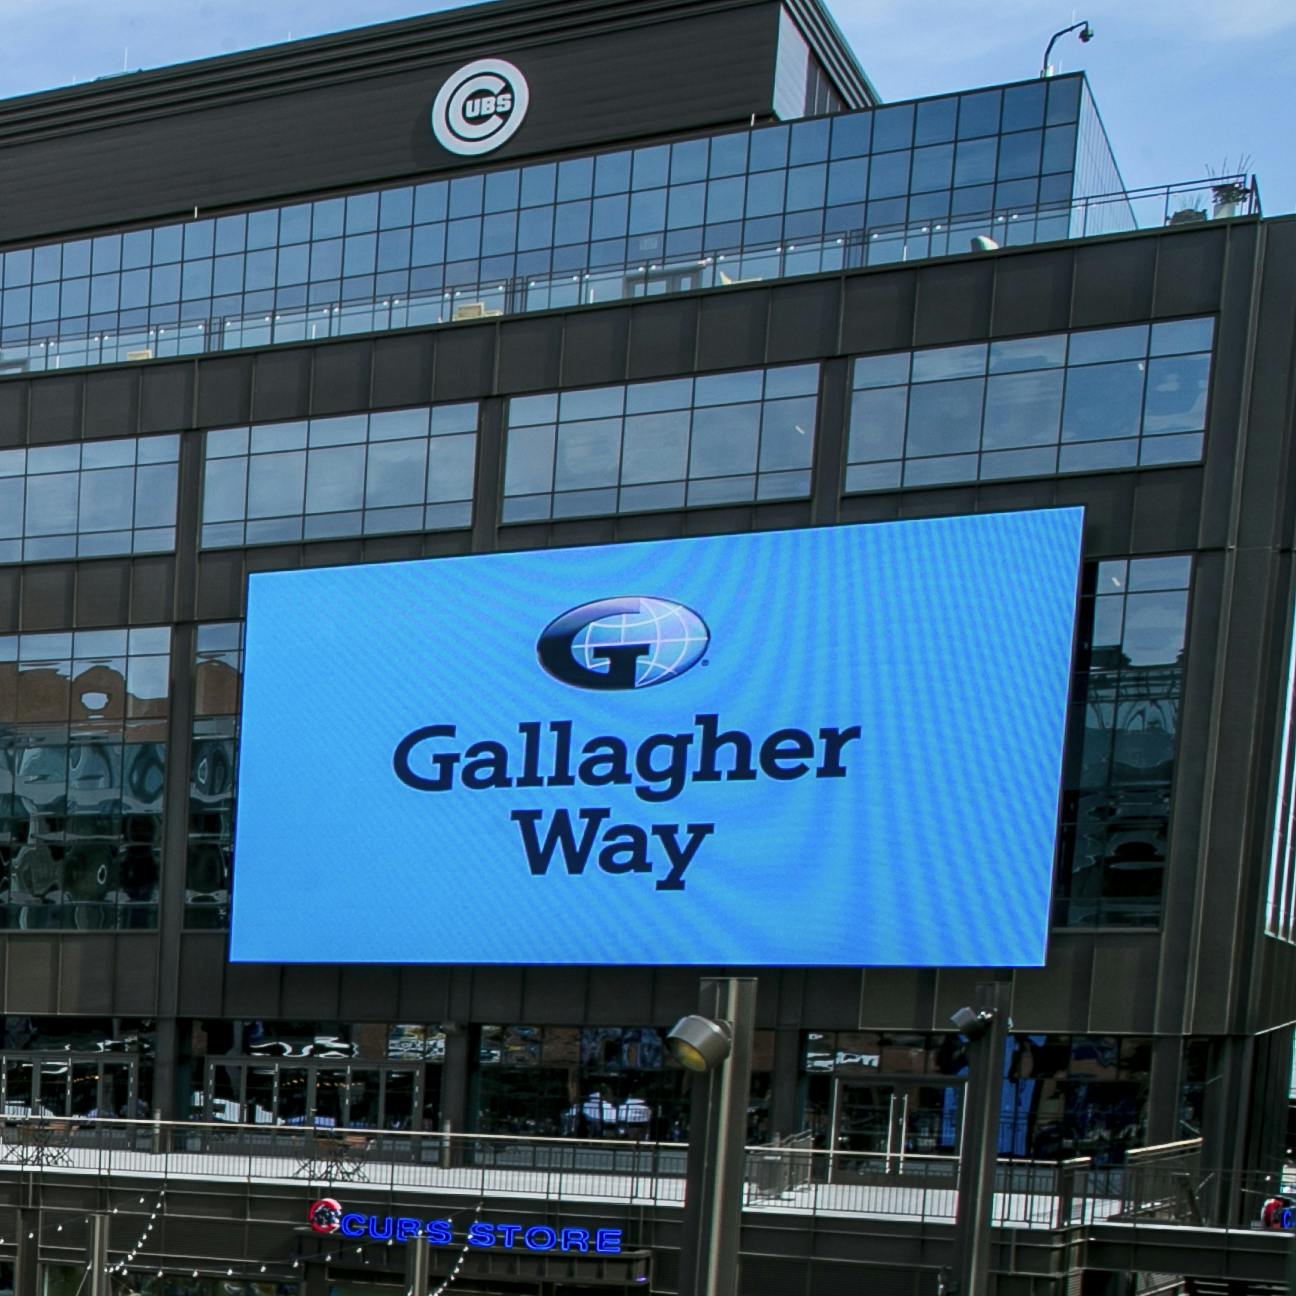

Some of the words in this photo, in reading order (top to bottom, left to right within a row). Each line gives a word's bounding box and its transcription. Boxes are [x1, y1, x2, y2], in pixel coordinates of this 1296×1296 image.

[392, 713, 862, 803] Gallagher
[510, 807, 715, 891] Way
[340, 1213, 453, 1245] CUBS
[467, 1222, 623, 1253] STORE
